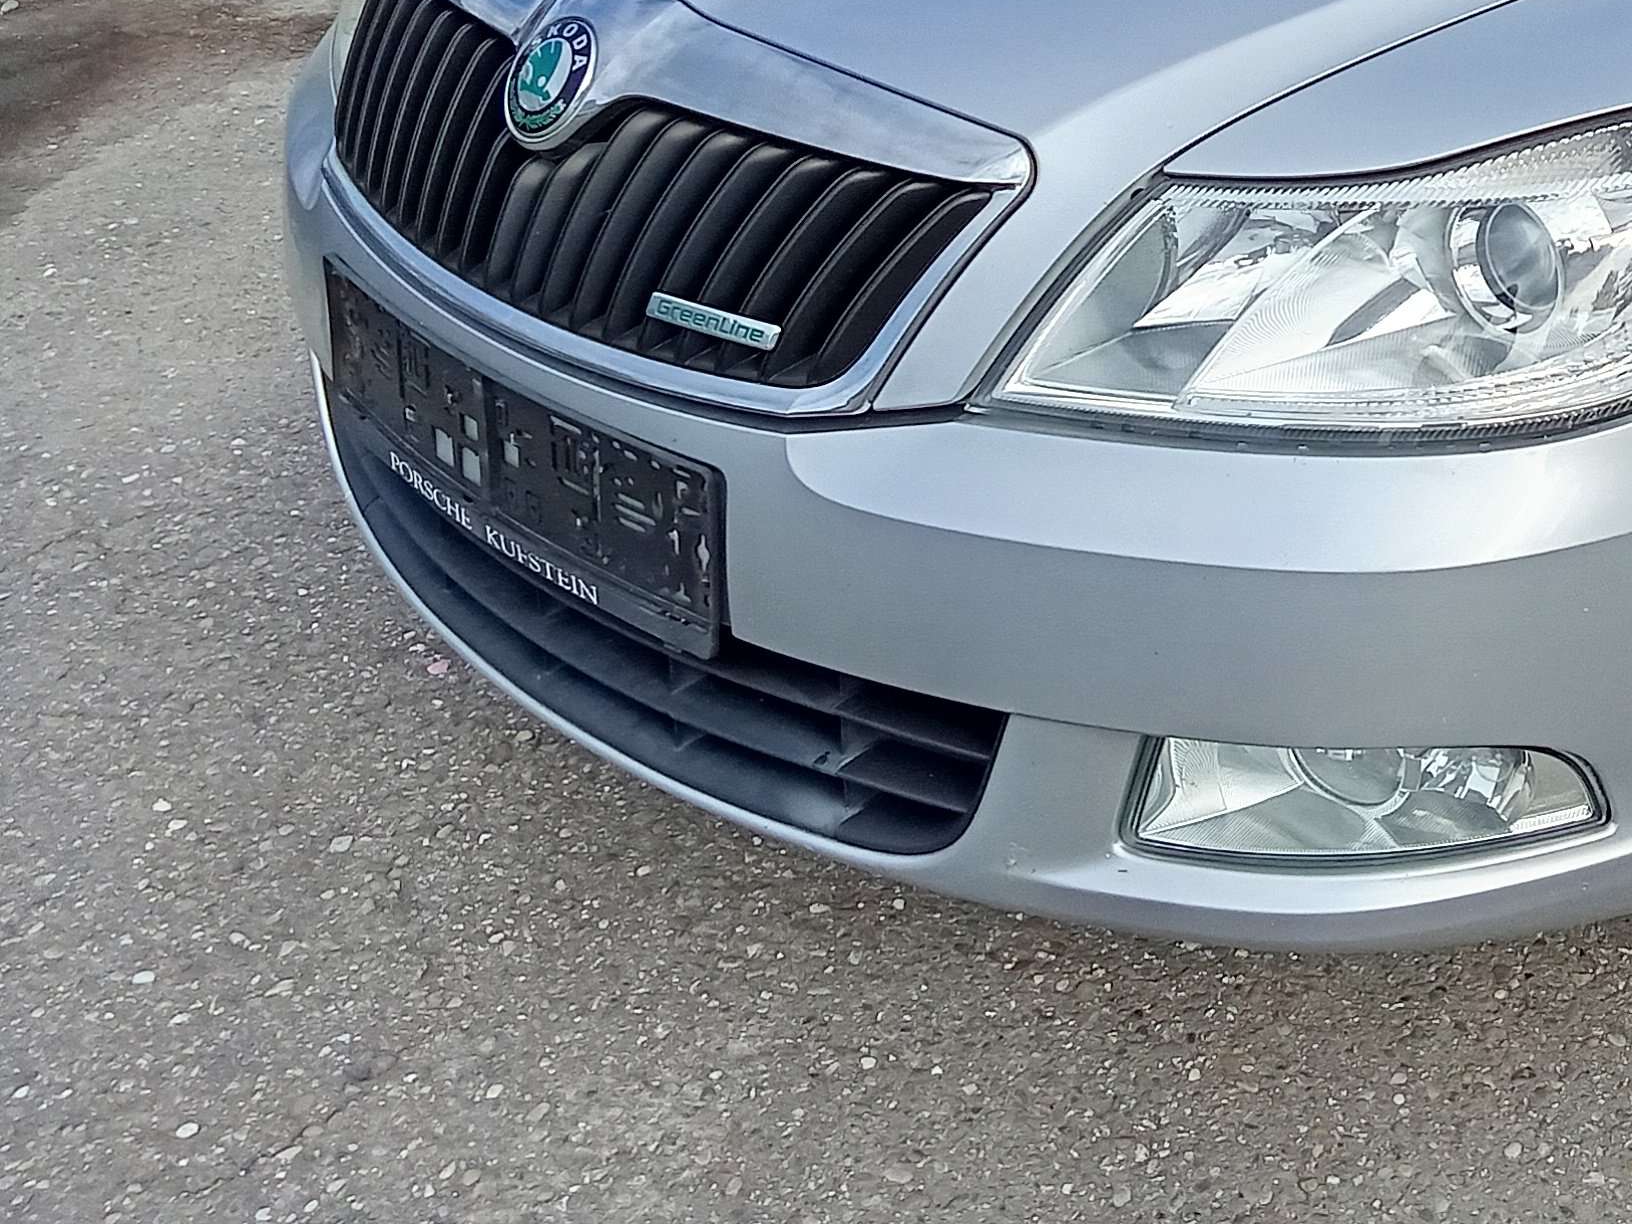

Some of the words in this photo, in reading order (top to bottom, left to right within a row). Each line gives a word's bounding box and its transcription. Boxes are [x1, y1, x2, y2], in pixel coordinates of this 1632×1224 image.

[656, 298, 766, 344] GreenLine
[389, 451, 473, 531] PORSCHE
[485, 524, 599, 606] KUFSTEIN
